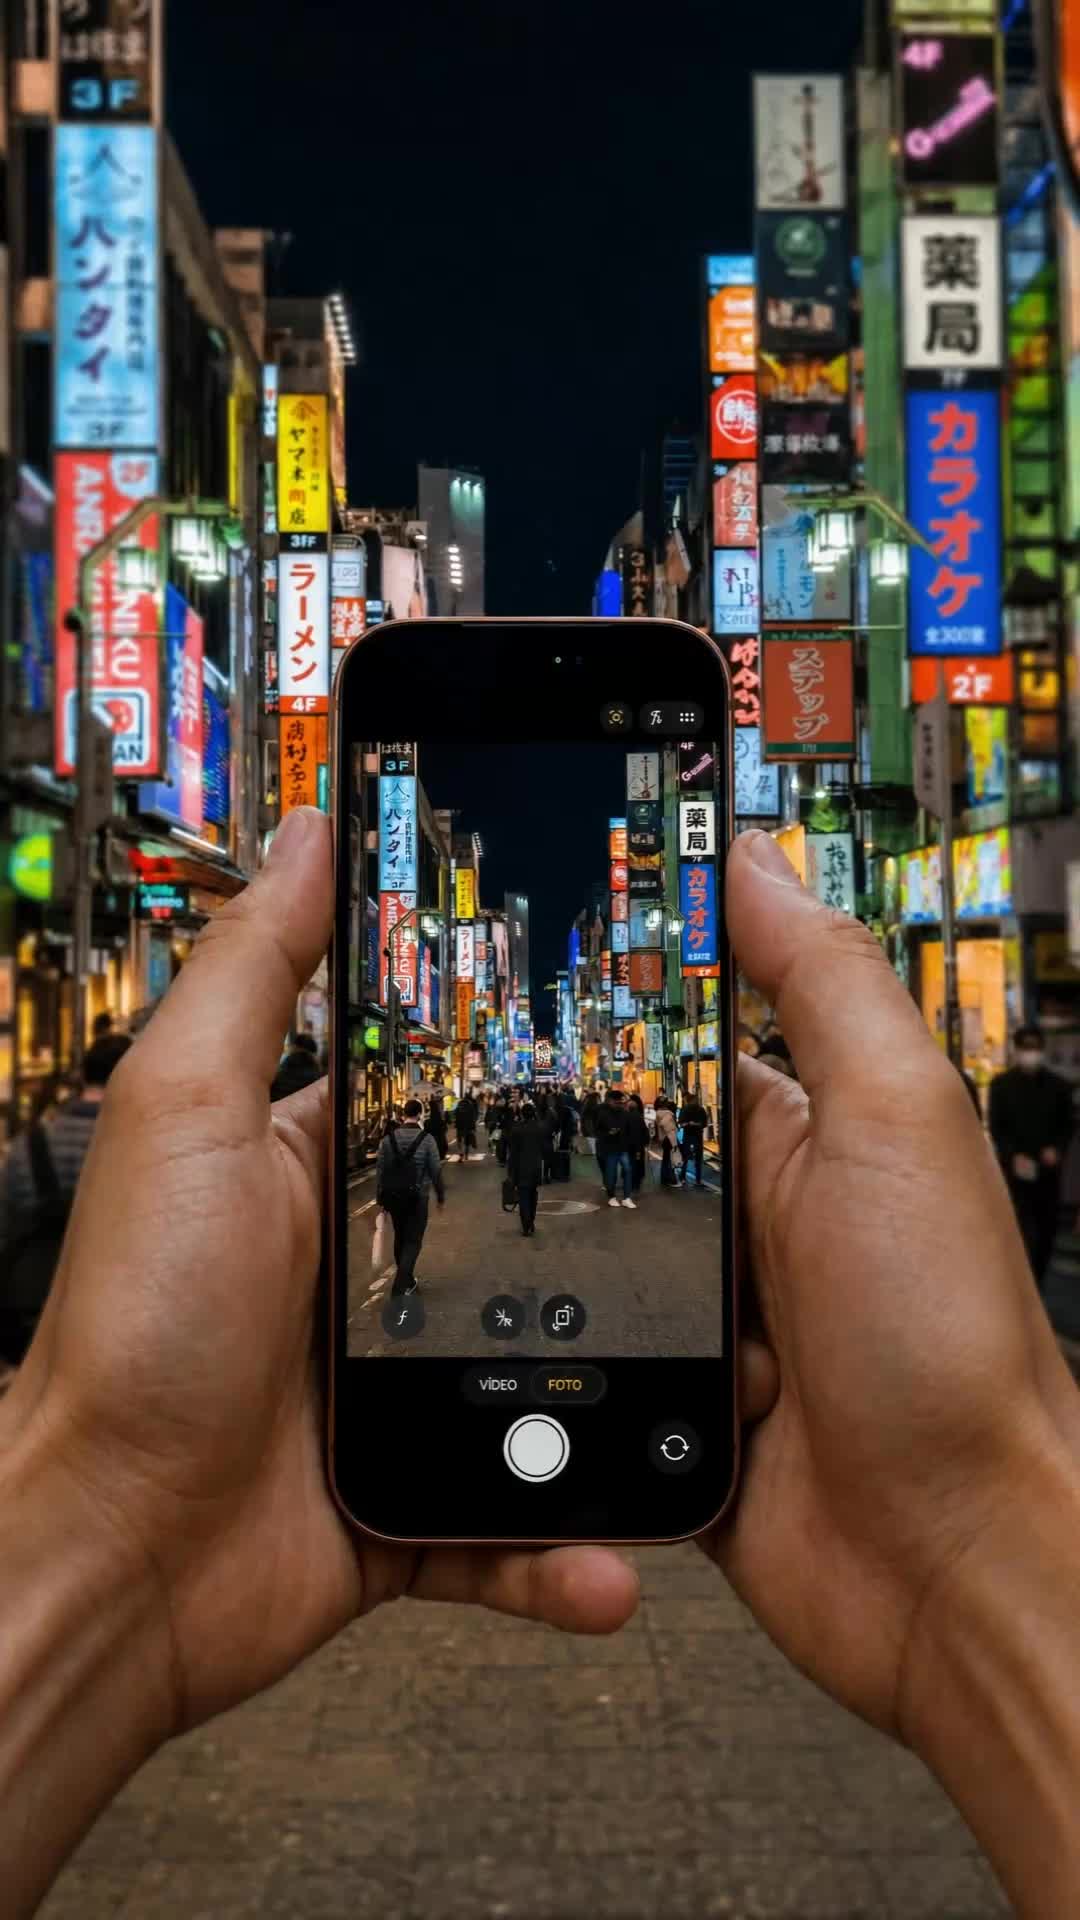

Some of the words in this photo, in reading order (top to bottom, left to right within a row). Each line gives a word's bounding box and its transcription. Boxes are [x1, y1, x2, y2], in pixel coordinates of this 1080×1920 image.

[70, 79, 138, 110] 3F
[69, 215, 116, 383] ハンタイ
[923, 233, 981, 356] 薬局
[928, 401, 983, 617] カラオケ
[290, 563, 318, 683] ラーメン
[291, 697, 318, 712] 4F
[787, 647, 829, 740] ステップ
[953, 674, 994, 700] 2F
[385, 760, 410, 772] 3F
[385, 808, 402, 868] ハンタイ
[686, 808, 707, 851] 薬局
[687, 867, 710, 949] カラオケ
[461, 929, 471, 972] ラーメン
[548, 1378, 582, 1391] FOTO
